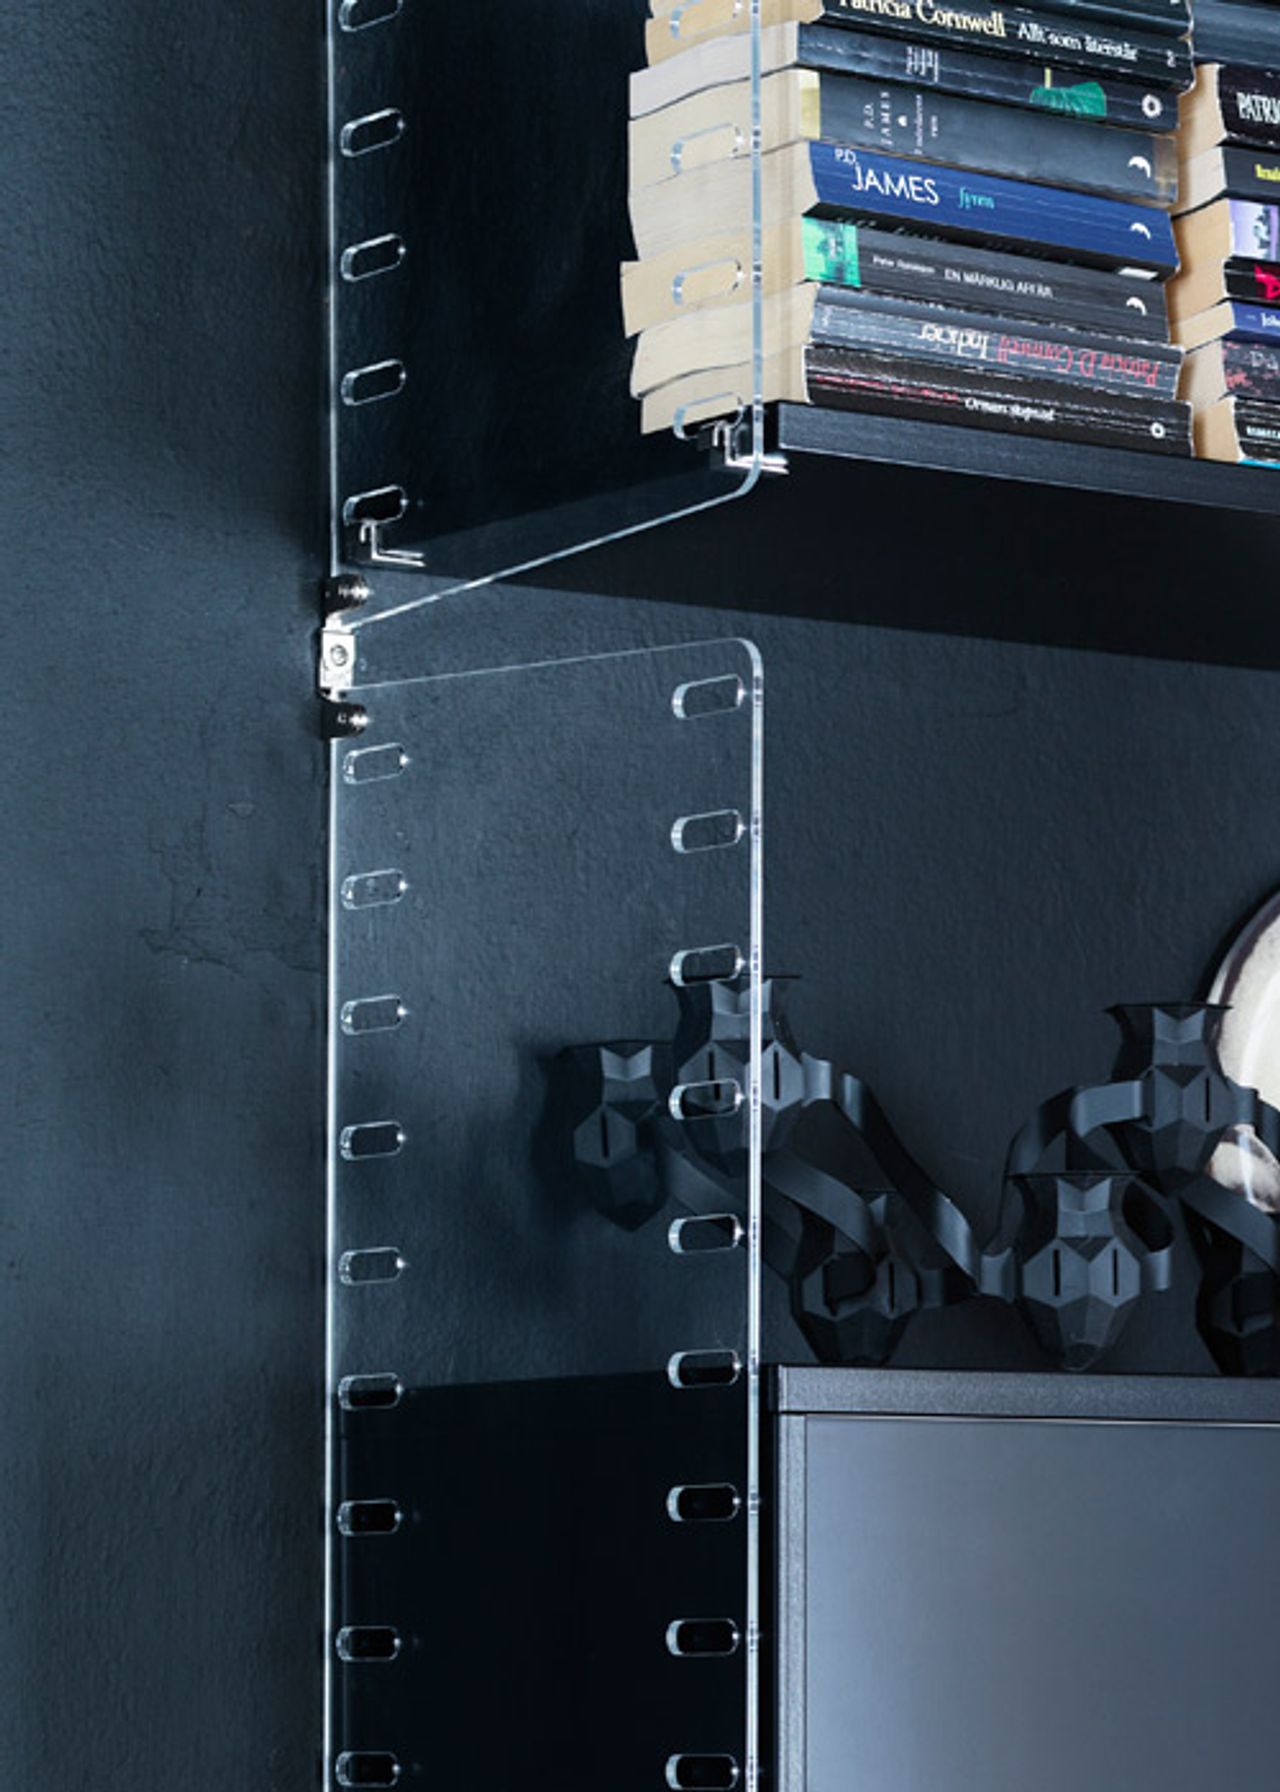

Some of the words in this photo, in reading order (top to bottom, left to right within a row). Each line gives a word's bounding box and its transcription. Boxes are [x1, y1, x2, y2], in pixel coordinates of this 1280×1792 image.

[916, 0, 1006, 37] Cornwell
[880, 91, 893, 146] JAMES
[851, 165, 939, 206] JAMES
[944, 268, 962, 282] EN
